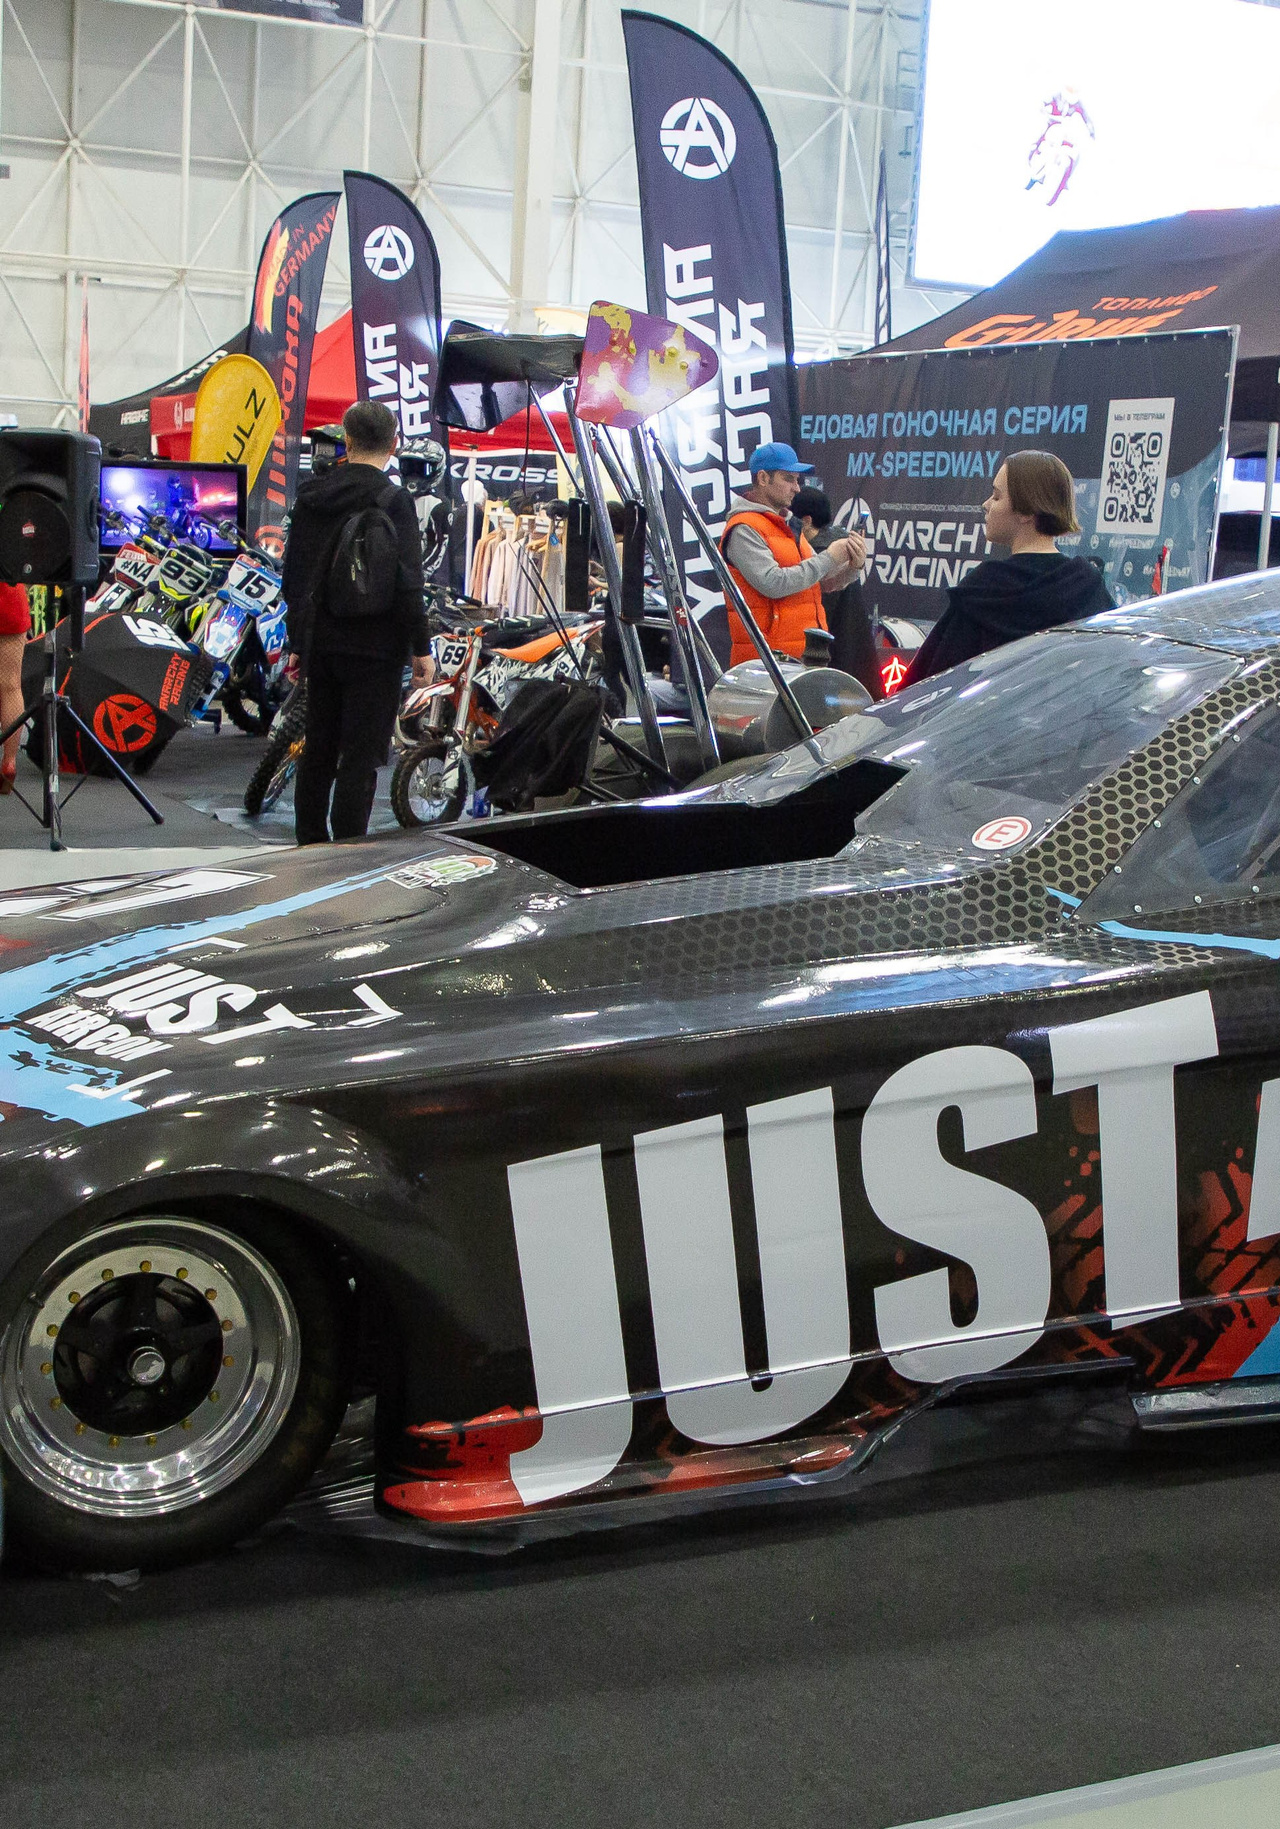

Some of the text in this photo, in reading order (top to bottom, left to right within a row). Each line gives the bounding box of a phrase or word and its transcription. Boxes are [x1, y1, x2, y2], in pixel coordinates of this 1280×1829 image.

[273, 204, 337, 298] GERMANY
[1092, 285, 1219, 311] ТОПЛИВО
[222, 387, 267, 465] ULZ
[882, 407, 997, 438] ГОНОЧНАЯ
[1003, 404, 1089, 435] СЕРИЯ
[846, 450, 1001, 478] MX-SPEEDWAY
[162, 559, 205, 592] 93
[234, 569, 273, 599] 15
[441, 644, 469, 666] 69
[159, 652, 183, 712] ANARCHY
[170, 659, 191, 707] RACING
[75, 962, 317, 1045] JUST
[24, 1004, 174, 1062] AIRCON
[507, 989, 1220, 1506] JUST
